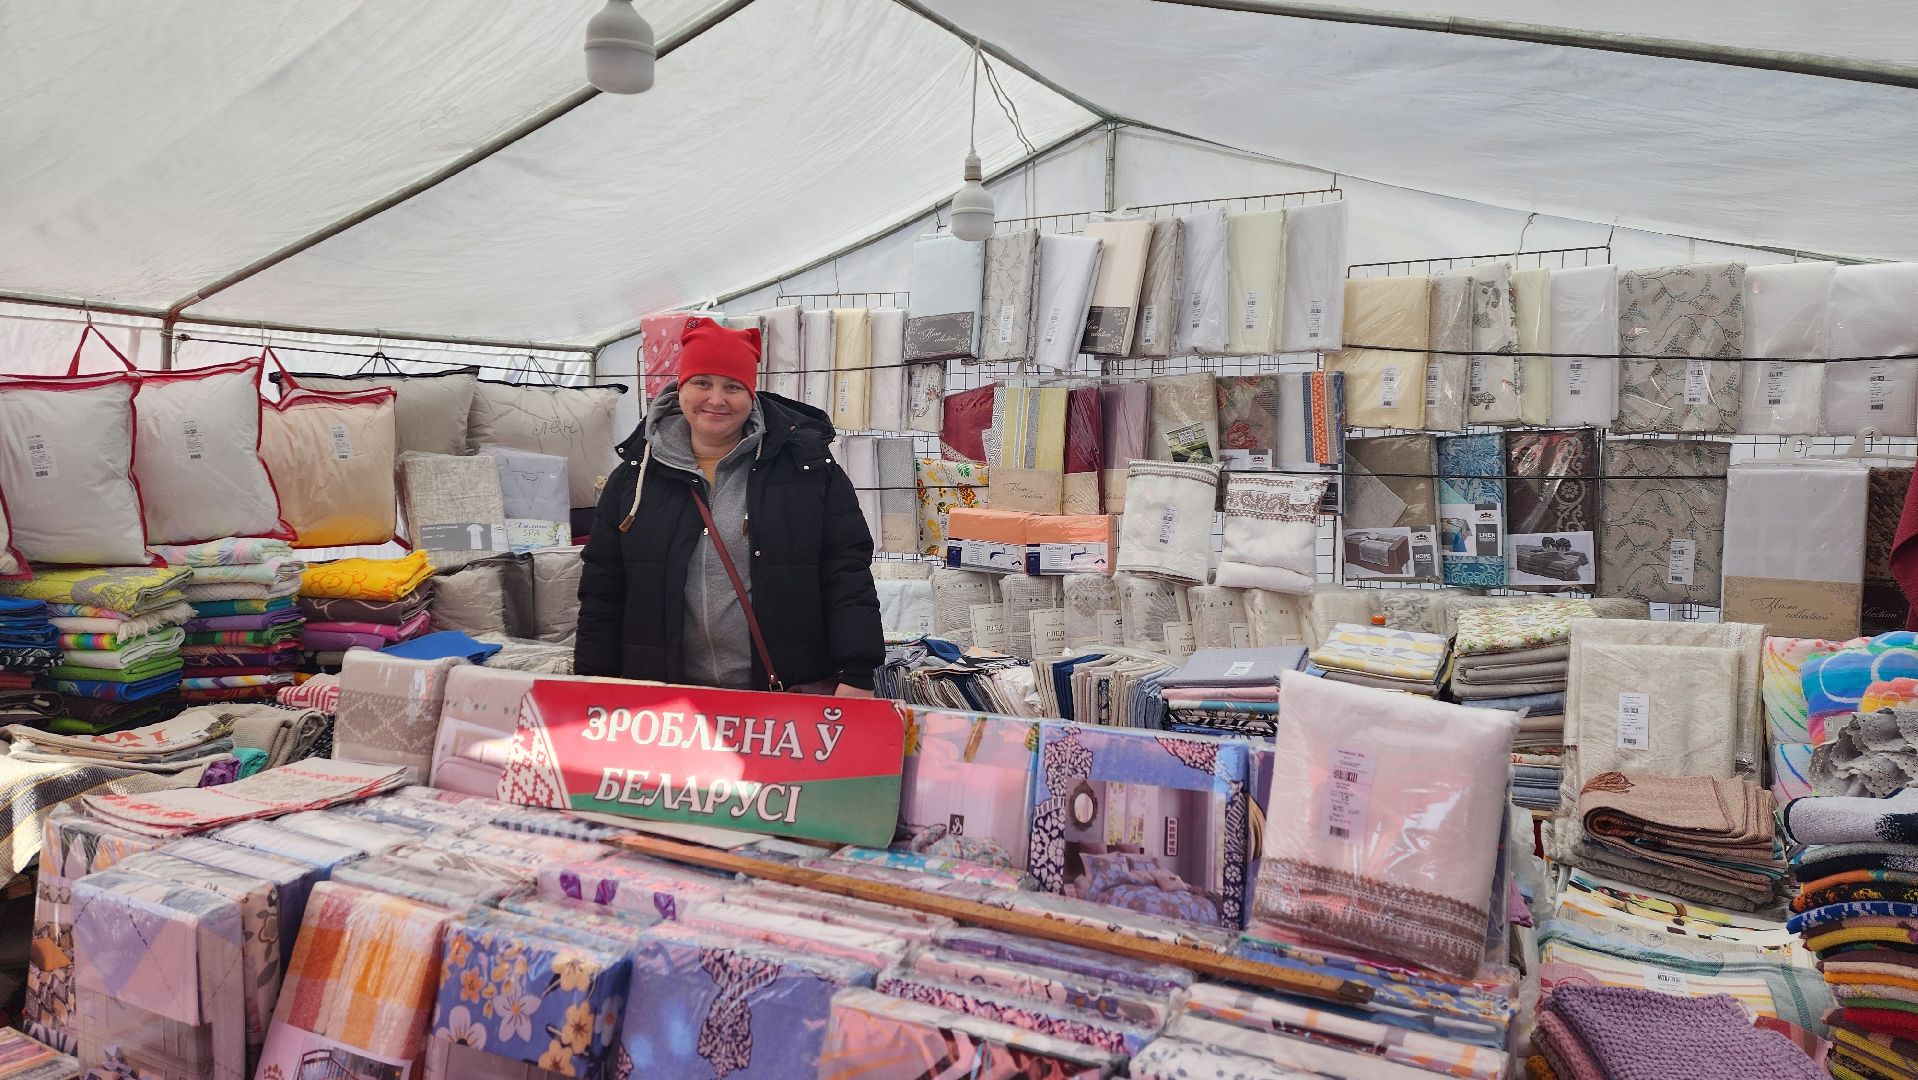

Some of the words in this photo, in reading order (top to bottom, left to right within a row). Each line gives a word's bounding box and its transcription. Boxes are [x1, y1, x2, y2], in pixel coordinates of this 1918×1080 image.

[1750, 597, 1798, 615] Home
[581, 705, 804, 760] ЗРОБЛЕНА
[814, 706, 844, 762] Ў
[594, 767, 803, 824] БЕЛАРУСІ
